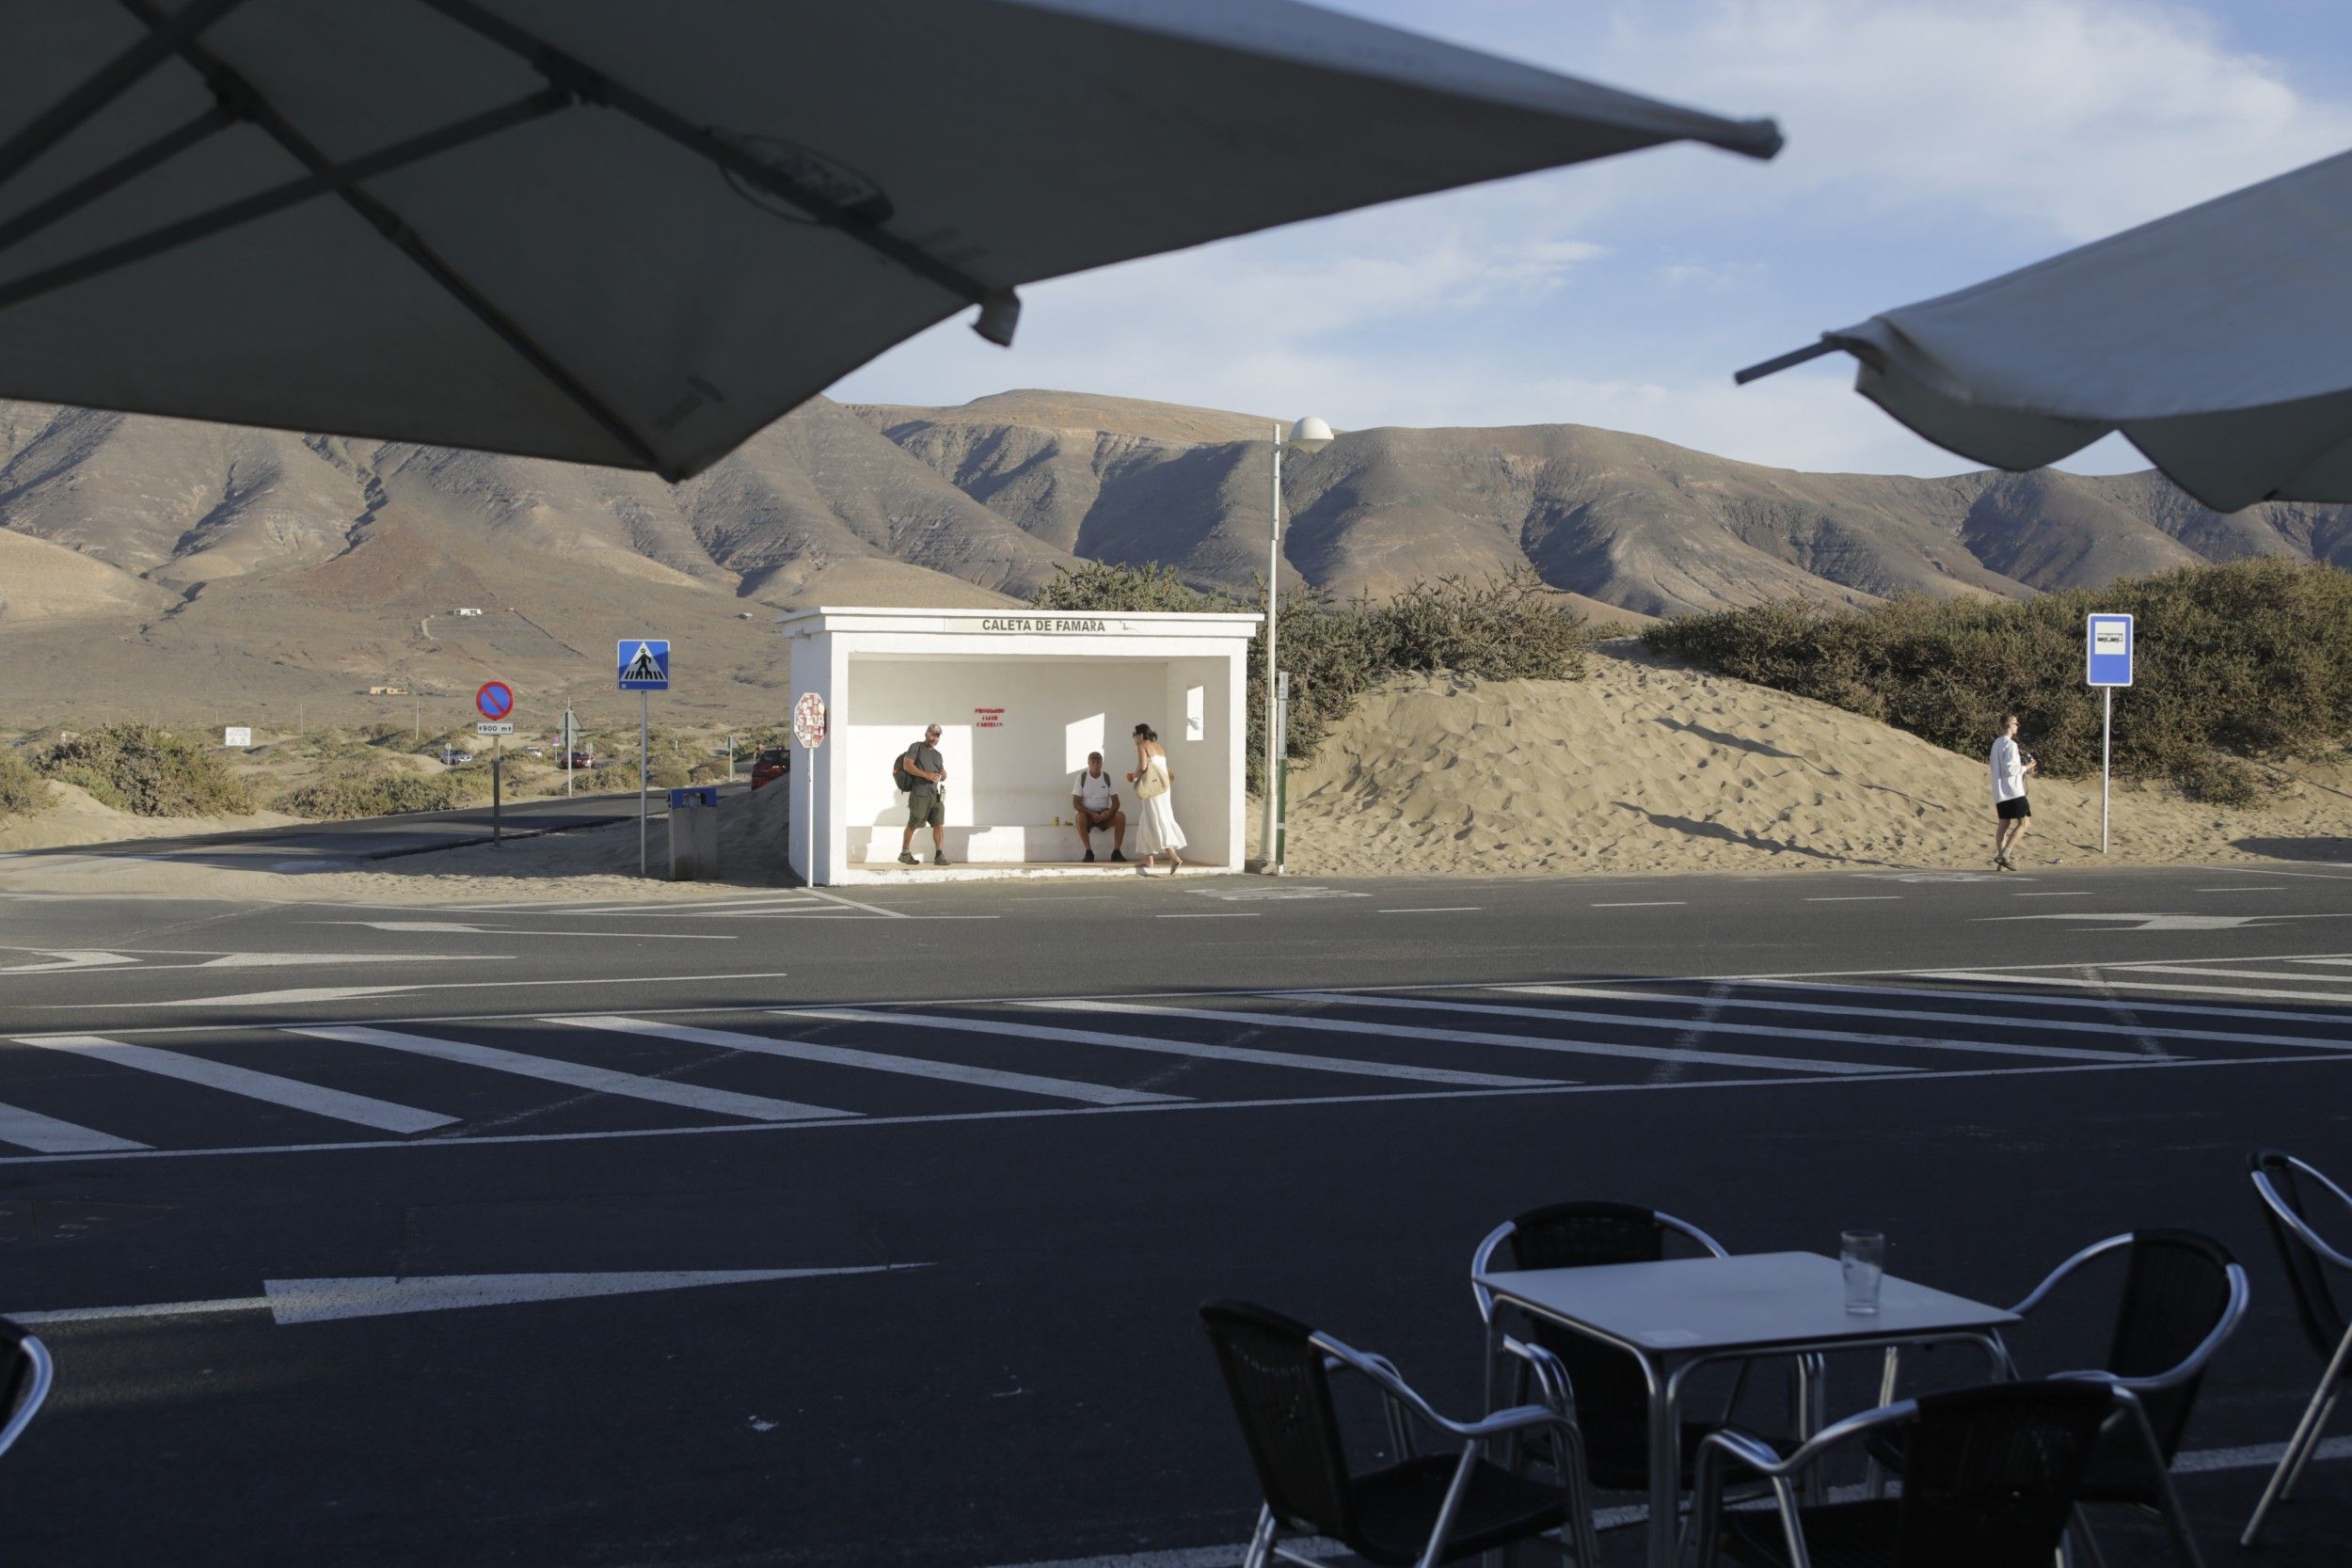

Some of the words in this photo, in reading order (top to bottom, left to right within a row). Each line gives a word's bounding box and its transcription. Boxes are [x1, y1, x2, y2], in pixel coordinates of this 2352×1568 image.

[982, 619, 1031, 631] CALETA
[1036, 620, 1052, 631] DE
[1057, 620, 1105, 632] FAMARA
